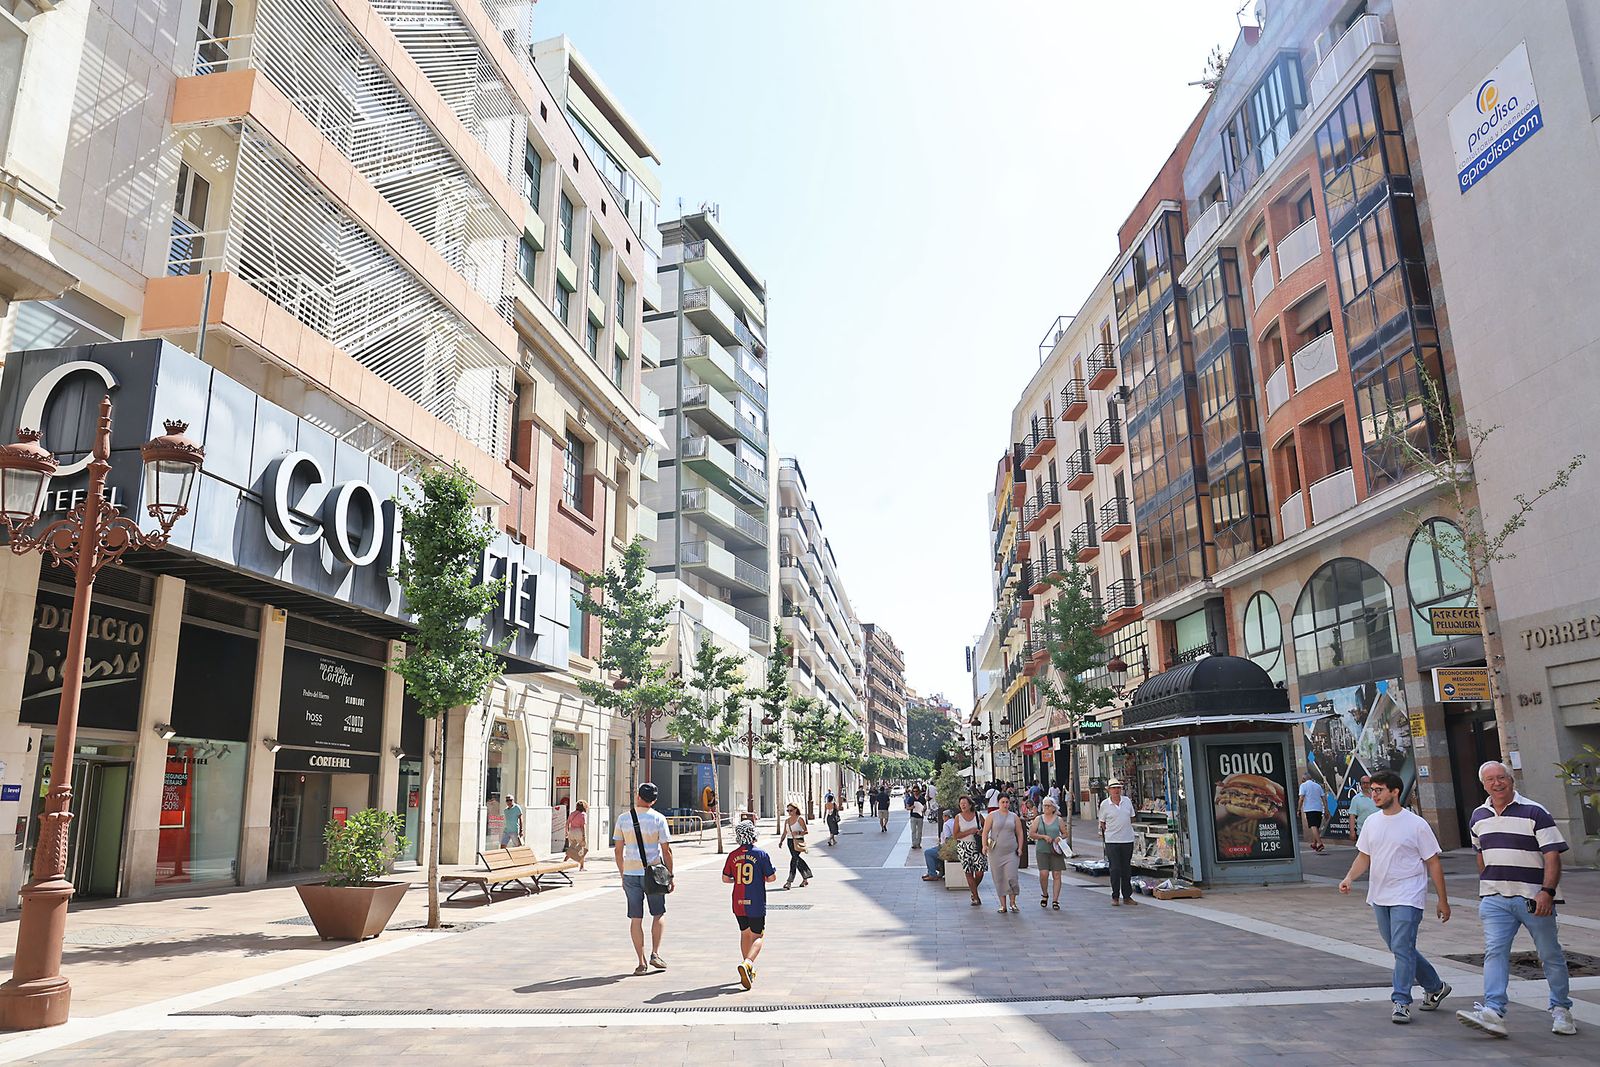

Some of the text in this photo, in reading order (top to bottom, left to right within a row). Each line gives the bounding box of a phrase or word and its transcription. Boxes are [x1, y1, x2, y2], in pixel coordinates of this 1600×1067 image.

[1468, 96, 1519, 152] prodisa
[1461, 114, 1539, 186] eprodisa.com
[321, 669, 354, 687] Cortefiel
[306, 710, 323, 722] hoss
[309, 755, 351, 768] CORTEFIEL
[1220, 752, 1274, 775] GOIKO
[735, 862, 754, 885] 19
